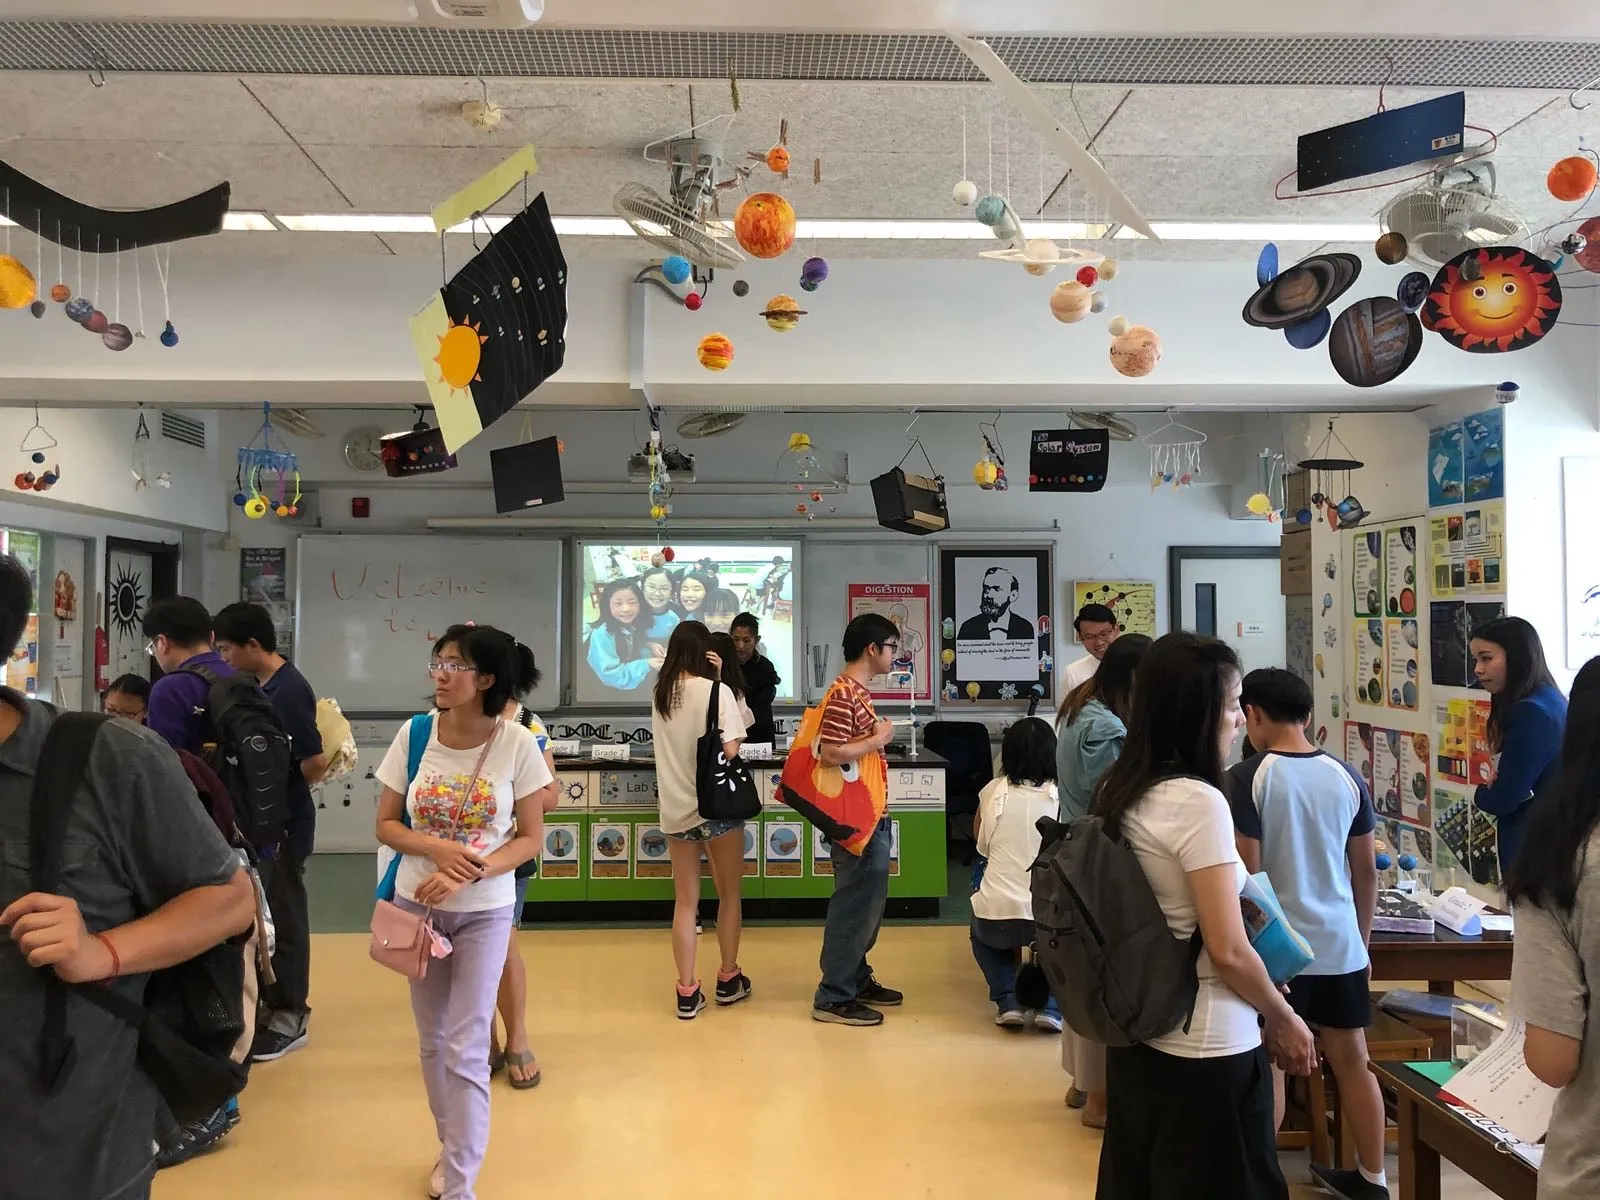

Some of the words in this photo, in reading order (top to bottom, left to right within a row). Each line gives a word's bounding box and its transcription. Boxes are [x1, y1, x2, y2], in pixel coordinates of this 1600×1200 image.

[1038, 442, 1062, 452] Solar
[1066, 441, 1100, 455] System
[331, 562, 486, 600] Welcome
[865, 586, 914, 594] DIGESTION
[552, 744, 570, 752] rade
[594, 749, 618, 757] Grade
[626, 781, 649, 793] Lab
